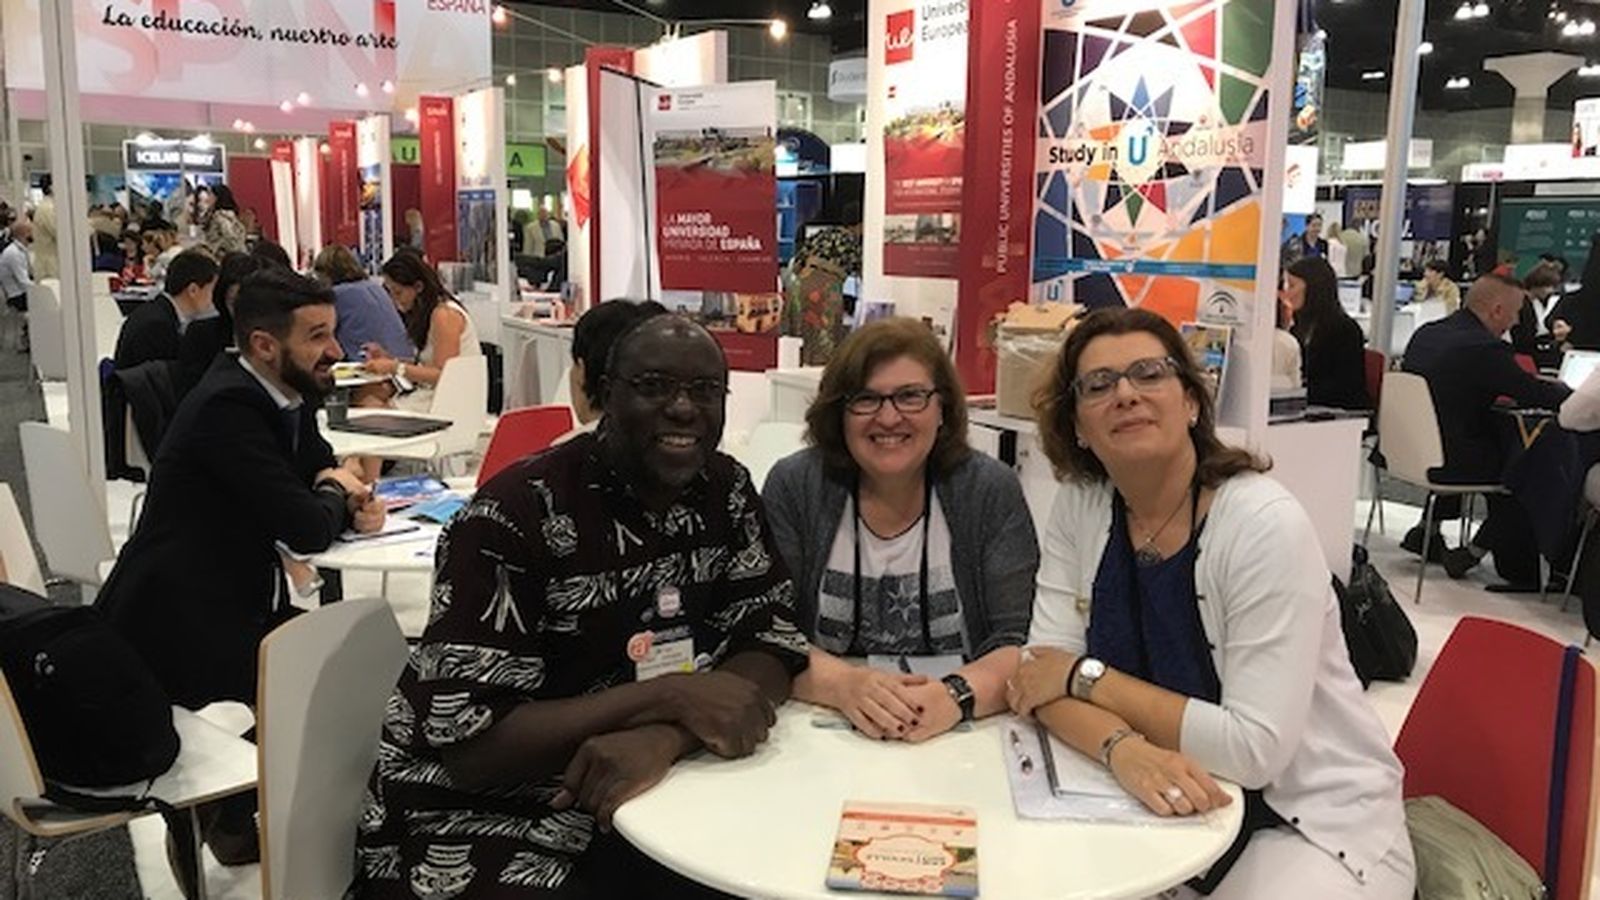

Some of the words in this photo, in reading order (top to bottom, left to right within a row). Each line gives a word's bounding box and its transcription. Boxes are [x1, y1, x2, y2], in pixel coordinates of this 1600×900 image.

[102, 4, 134, 27] La
[141, 9, 263, 41] educación,
[270, 26, 351, 46] nuestro
[356, 32, 398, 49] arte
[1003, 18, 1019, 104] ANDALUSIA
[1002, 105, 1015, 125] OF
[1049, 143, 1097, 166] Study
[1101, 142, 1119, 161] in
[1157, 131, 1255, 159] Andalusia
[998, 128, 1015, 221] UNIVERSITIES
[661, 225, 730, 238] UNIVERSIDAD
[677, 211, 711, 224] MAYOR
[719, 235, 763, 250] ESPAÑA
[997, 223, 1010, 273] PUBLIC
